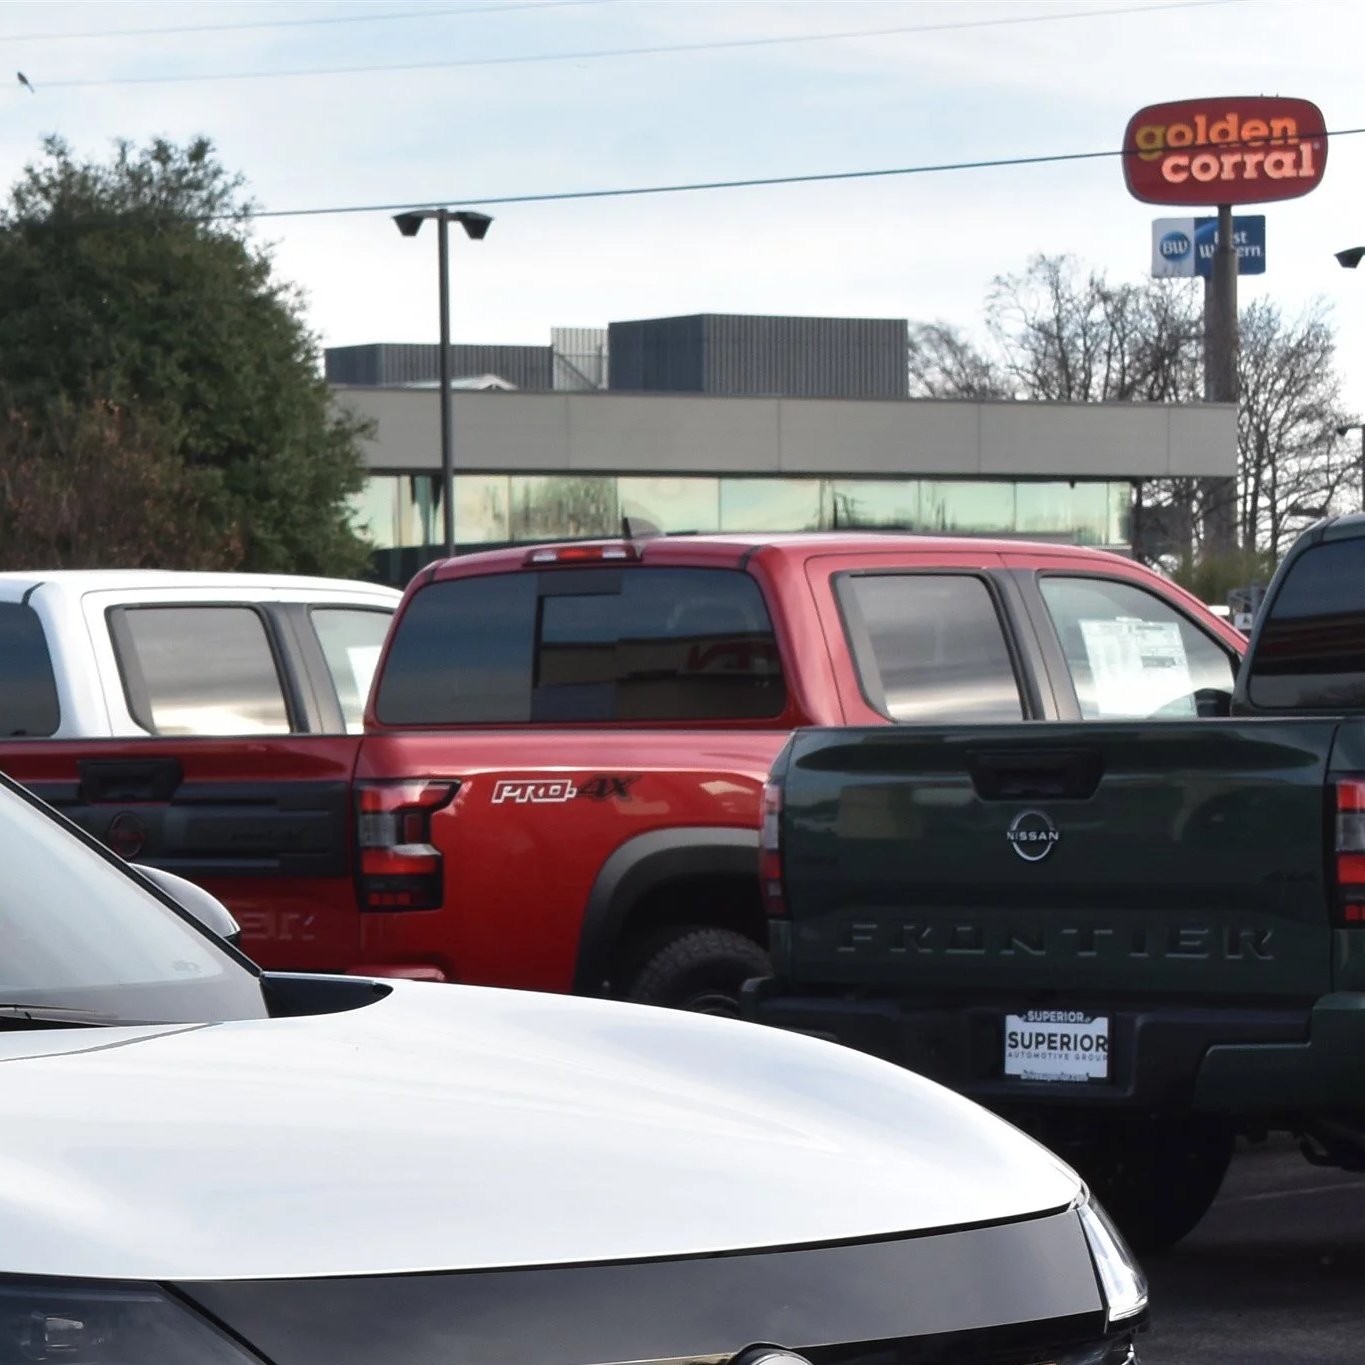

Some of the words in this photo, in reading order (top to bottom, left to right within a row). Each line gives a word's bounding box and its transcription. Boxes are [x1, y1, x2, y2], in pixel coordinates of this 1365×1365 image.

[1135, 113, 1300, 161] golden
[1161, 143, 1315, 183] corral
[1162, 240, 1187, 255] BW
[1199, 244, 1262, 259] Wern
[491, 773, 643, 804] PRO-4X
[1006, 830, 1060, 841] NISSAN
[836, 922, 1275, 961] FRONTIER
[1027, 1010, 1085, 1023] SUPERIOR
[1008, 1031, 1108, 1052] SUPERIOR
[1008, 1051, 1069, 1060] AUTOMOTIVE
